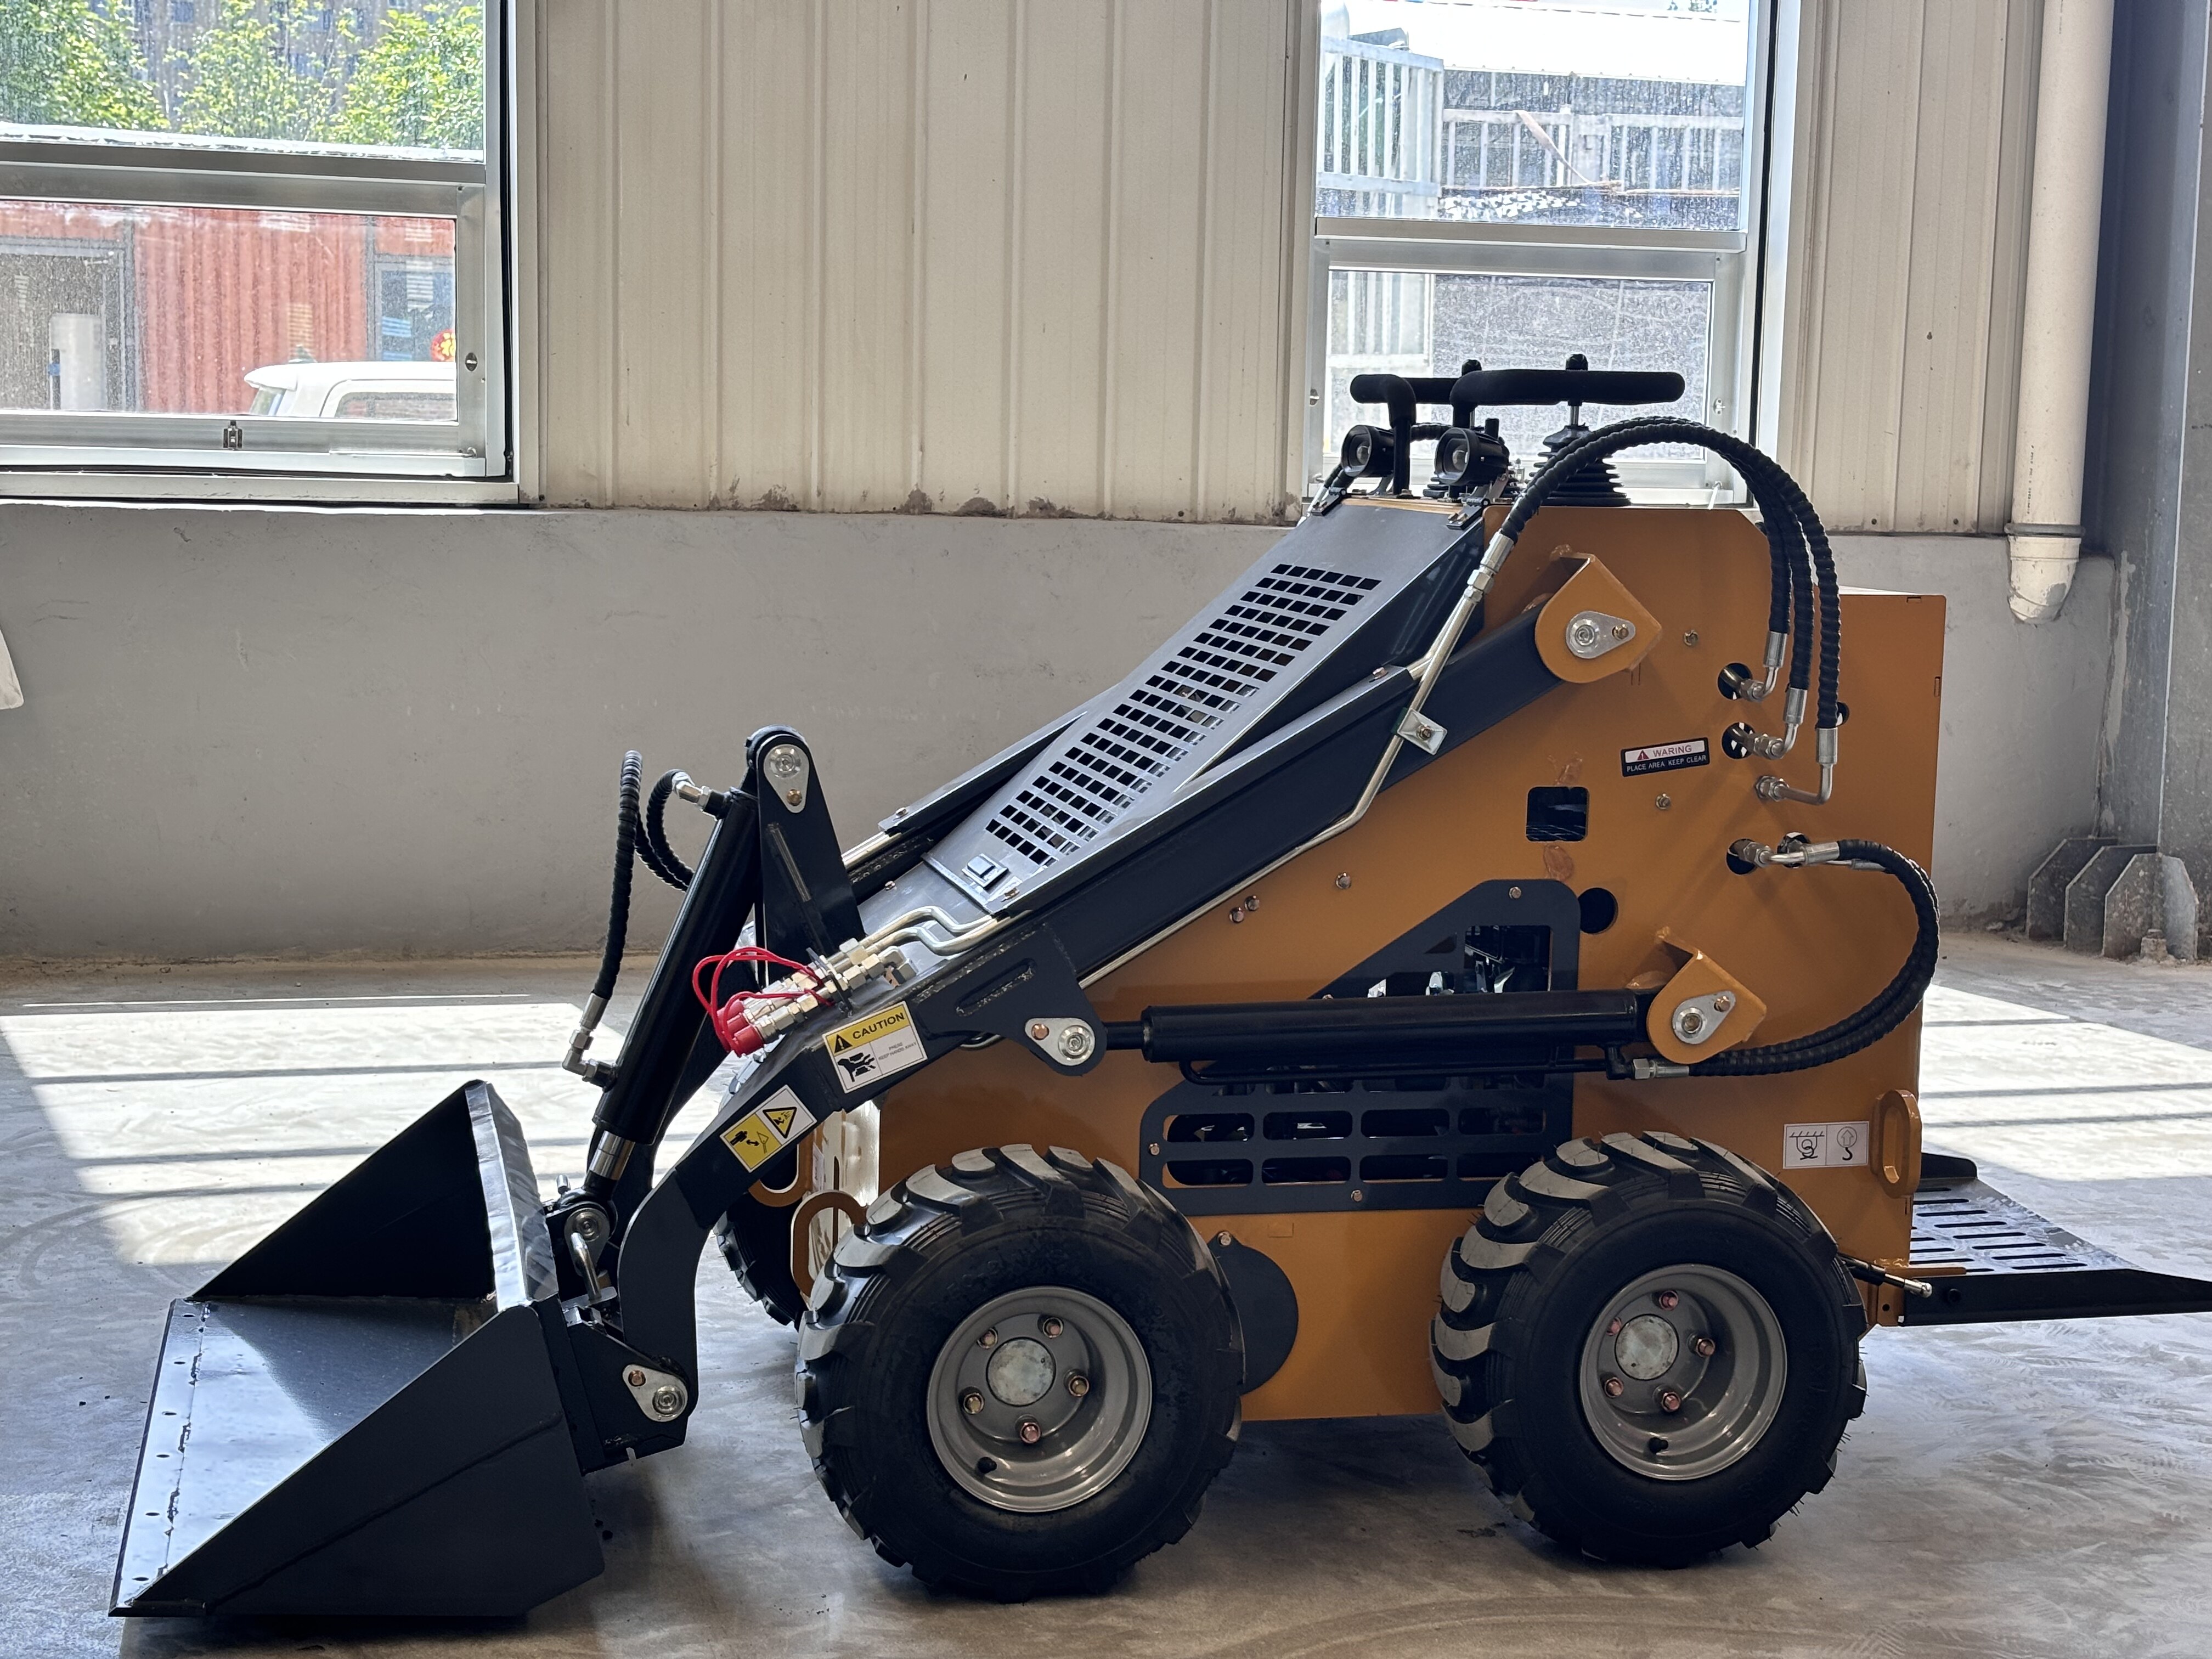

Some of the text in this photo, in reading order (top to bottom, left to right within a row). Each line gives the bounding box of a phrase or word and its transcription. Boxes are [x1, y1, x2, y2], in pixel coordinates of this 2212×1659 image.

[1653, 745, 1691, 757] WARING
[1627, 764, 1646, 772] PLACE
[1686, 755, 1706, 763] CLEAR
[853, 1013, 905, 1039] CAUTION
